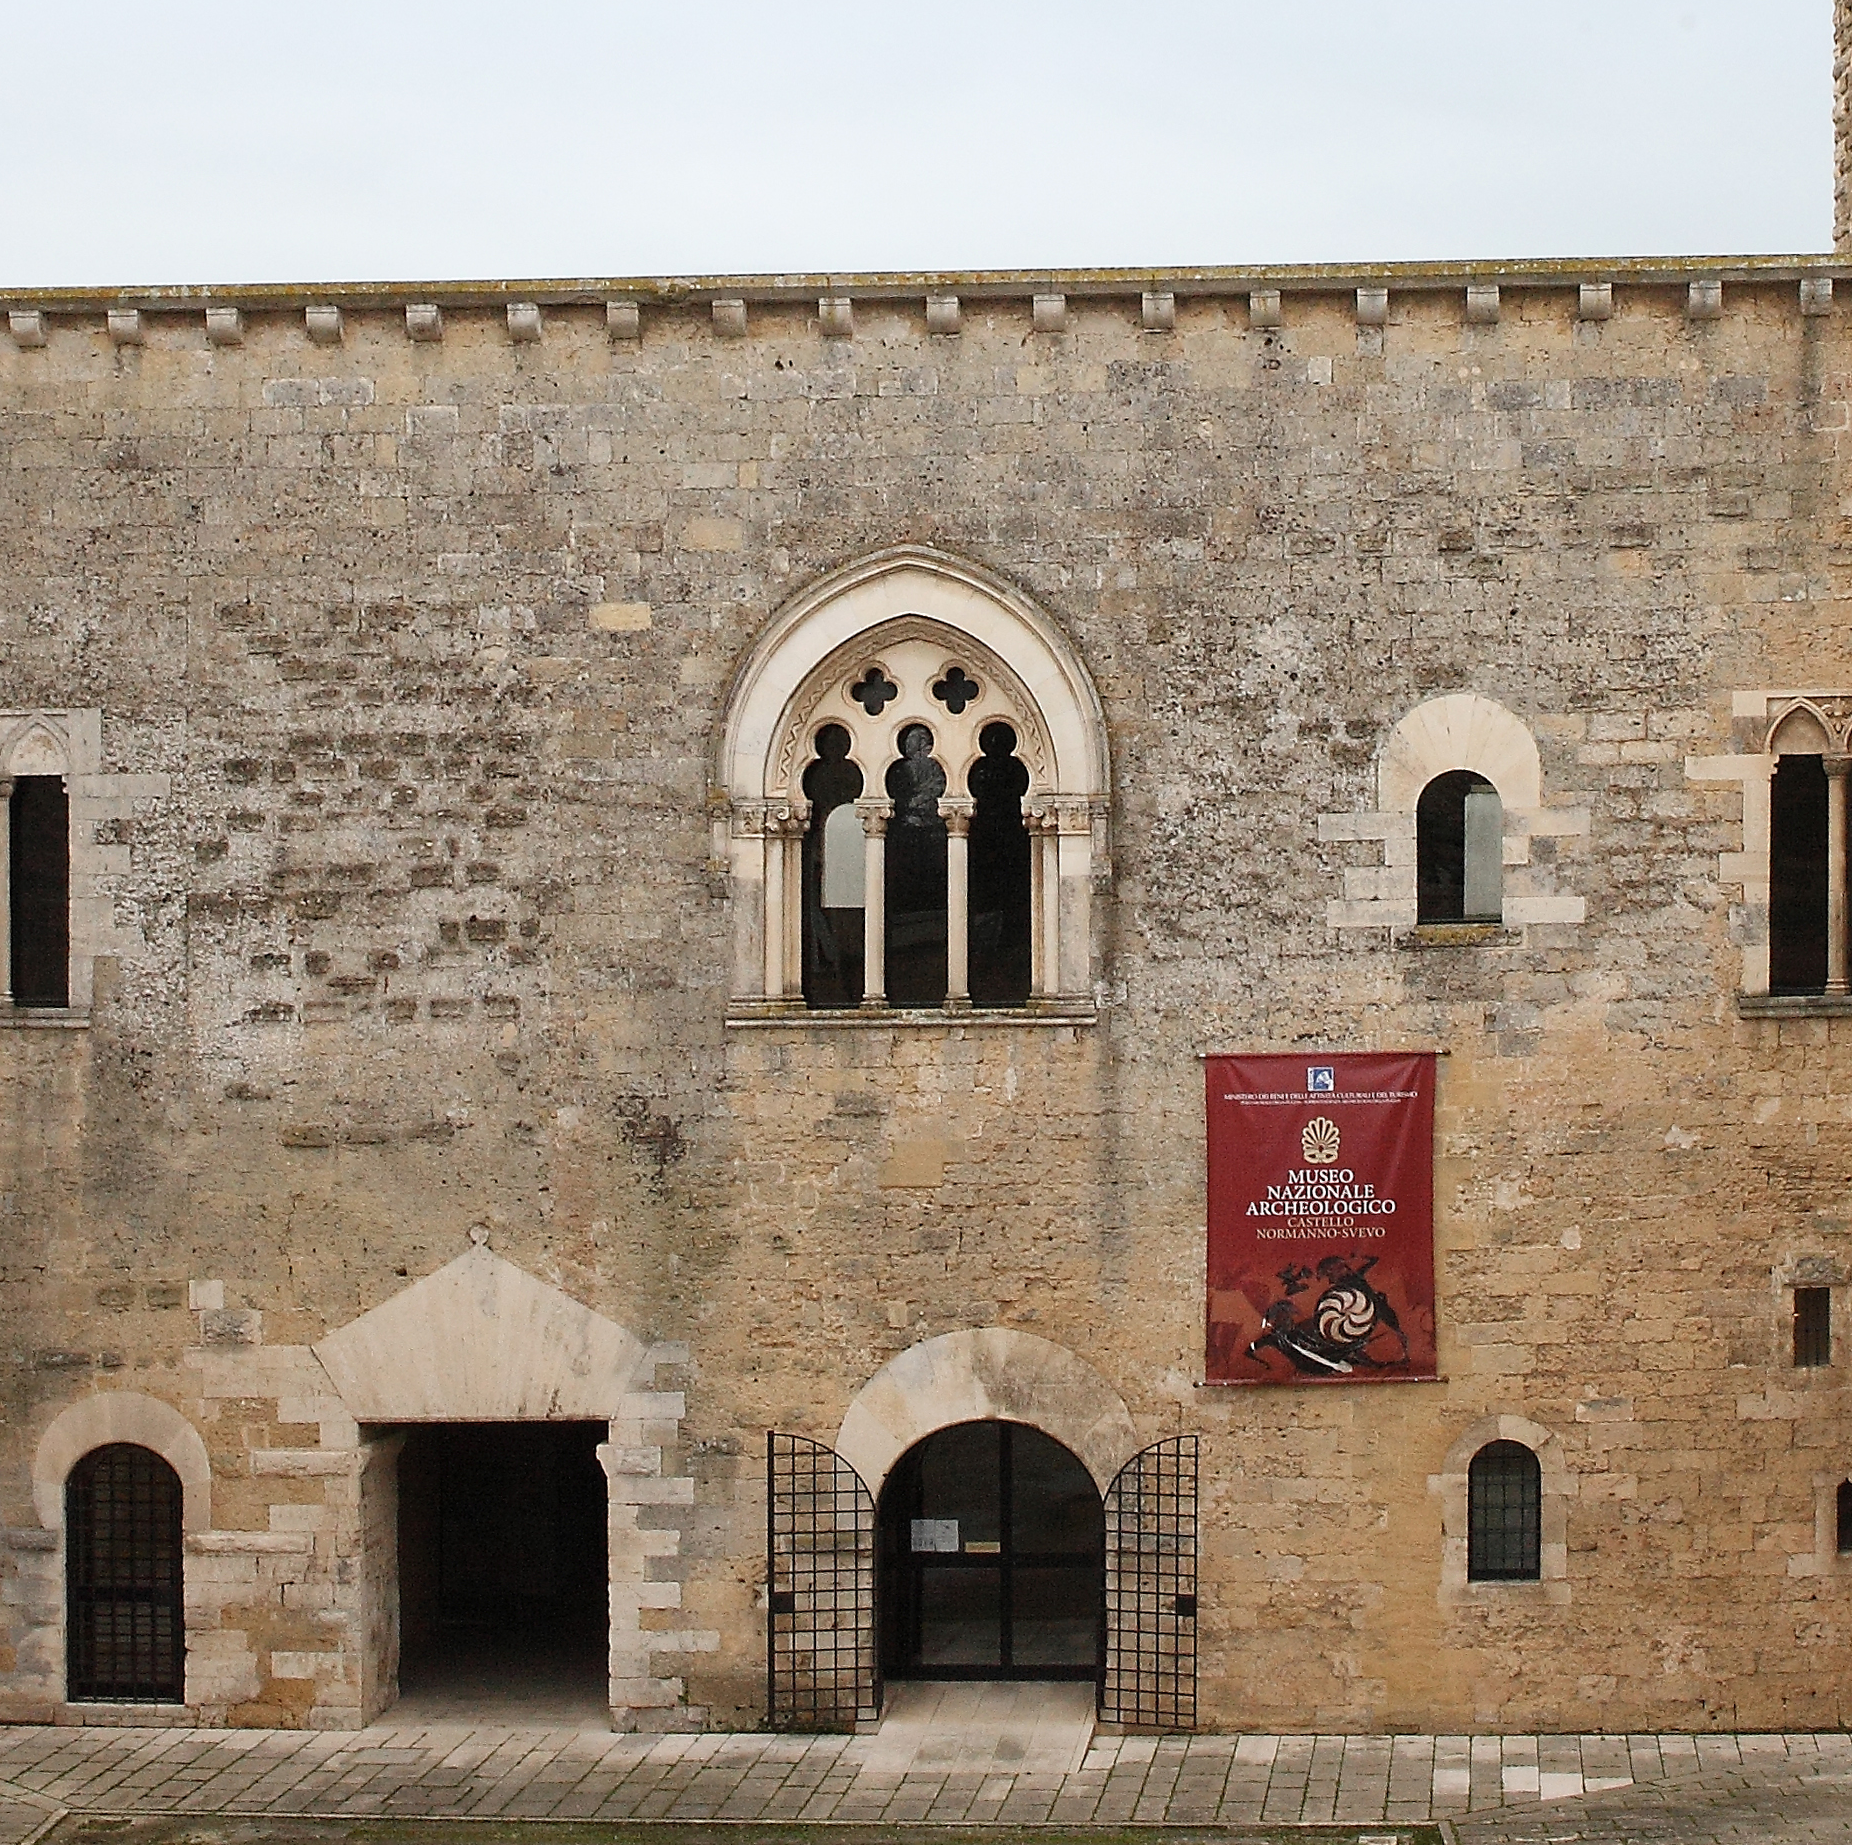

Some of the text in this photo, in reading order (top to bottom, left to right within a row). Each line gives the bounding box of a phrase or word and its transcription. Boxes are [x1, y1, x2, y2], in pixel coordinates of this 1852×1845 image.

[1288, 1169, 1354, 1184] MUSEO
[1266, 1184, 1375, 1200] NAZIONALE
[1245, 1199, 1396, 1216] ARCHEOLOGICO
[1287, 1216, 1355, 1228] CASTELLO
[1256, 1227, 1386, 1239] NORMANNO-SVEVO
